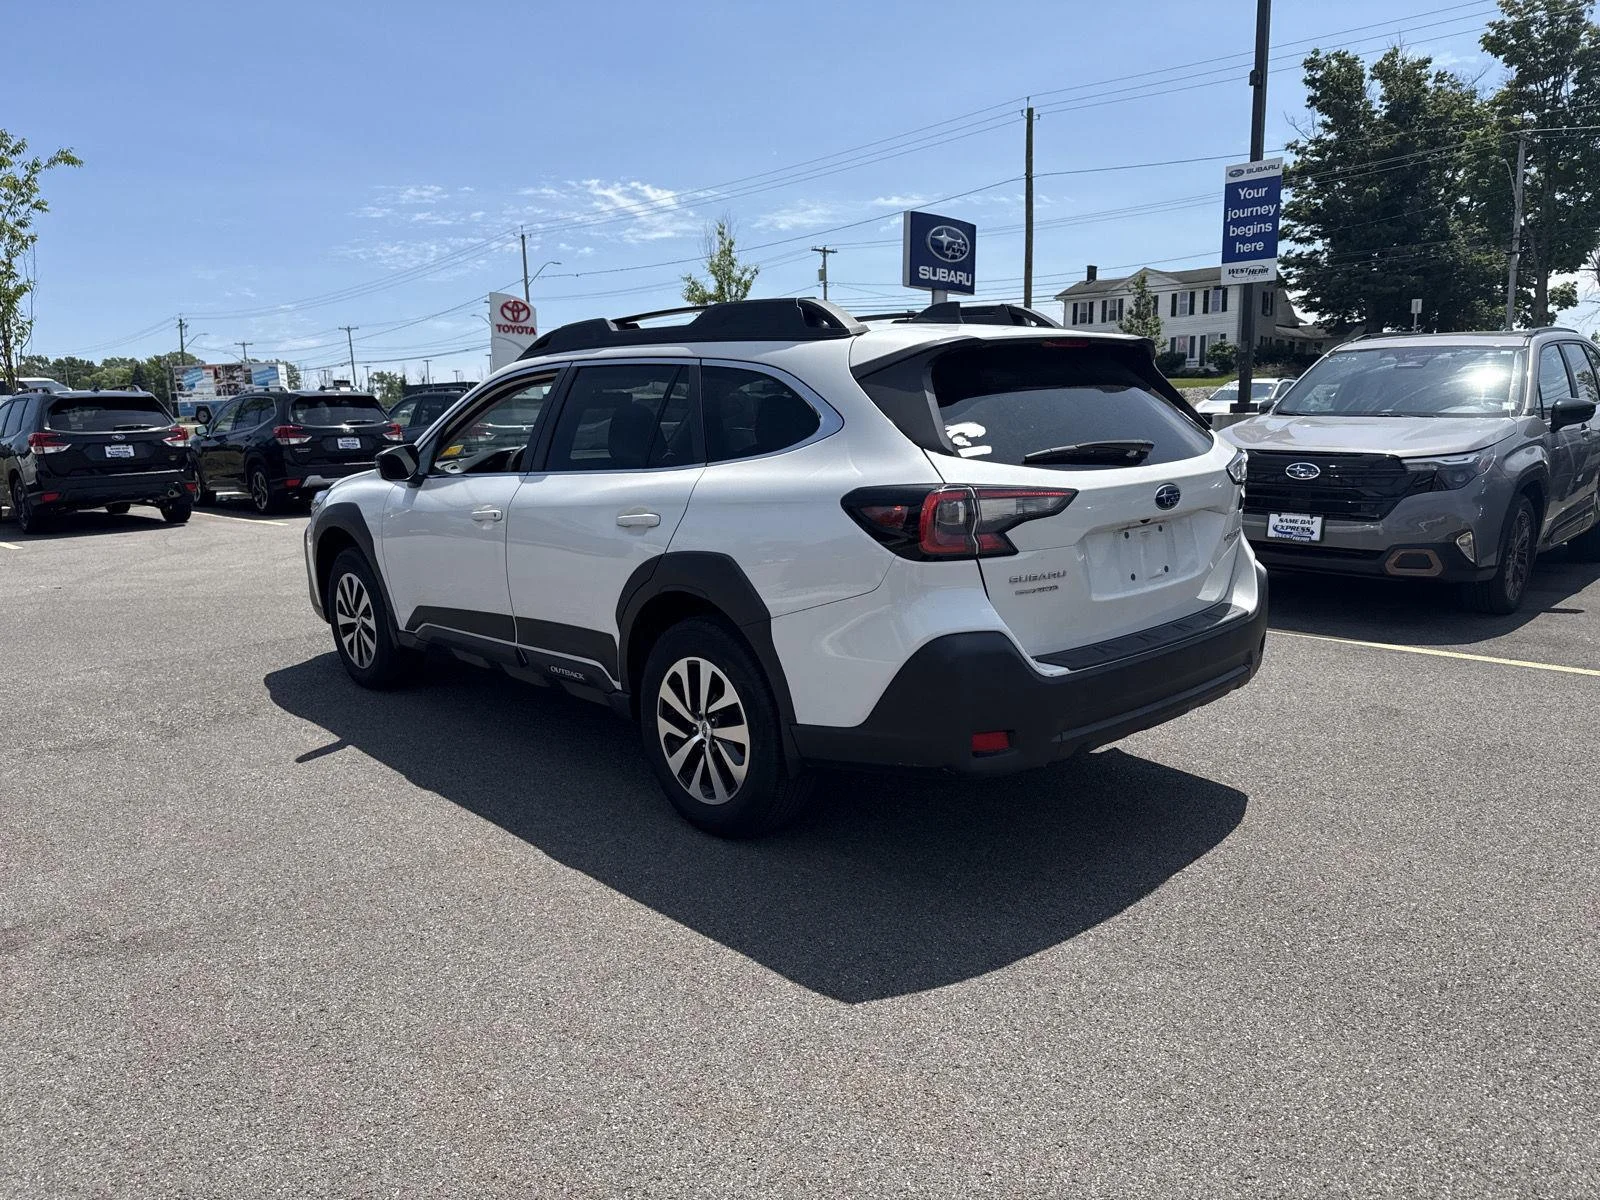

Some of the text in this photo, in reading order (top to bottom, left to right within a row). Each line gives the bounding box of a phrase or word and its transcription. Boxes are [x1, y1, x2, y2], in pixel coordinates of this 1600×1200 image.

[1246, 163, 1280, 175] SUBARU
[1238, 187, 1269, 200] Your
[1227, 204, 1277, 222] journey
[1229, 222, 1273, 237] begins
[1235, 241, 1265, 254] here
[918, 265, 972, 286] SUBARU
[496, 324, 536, 336] TOYOTA
[1278, 517, 1300, 525] SAME
[1275, 524, 1312, 533] EXPRESS
[550, 665, 585, 681] OUTBACK
